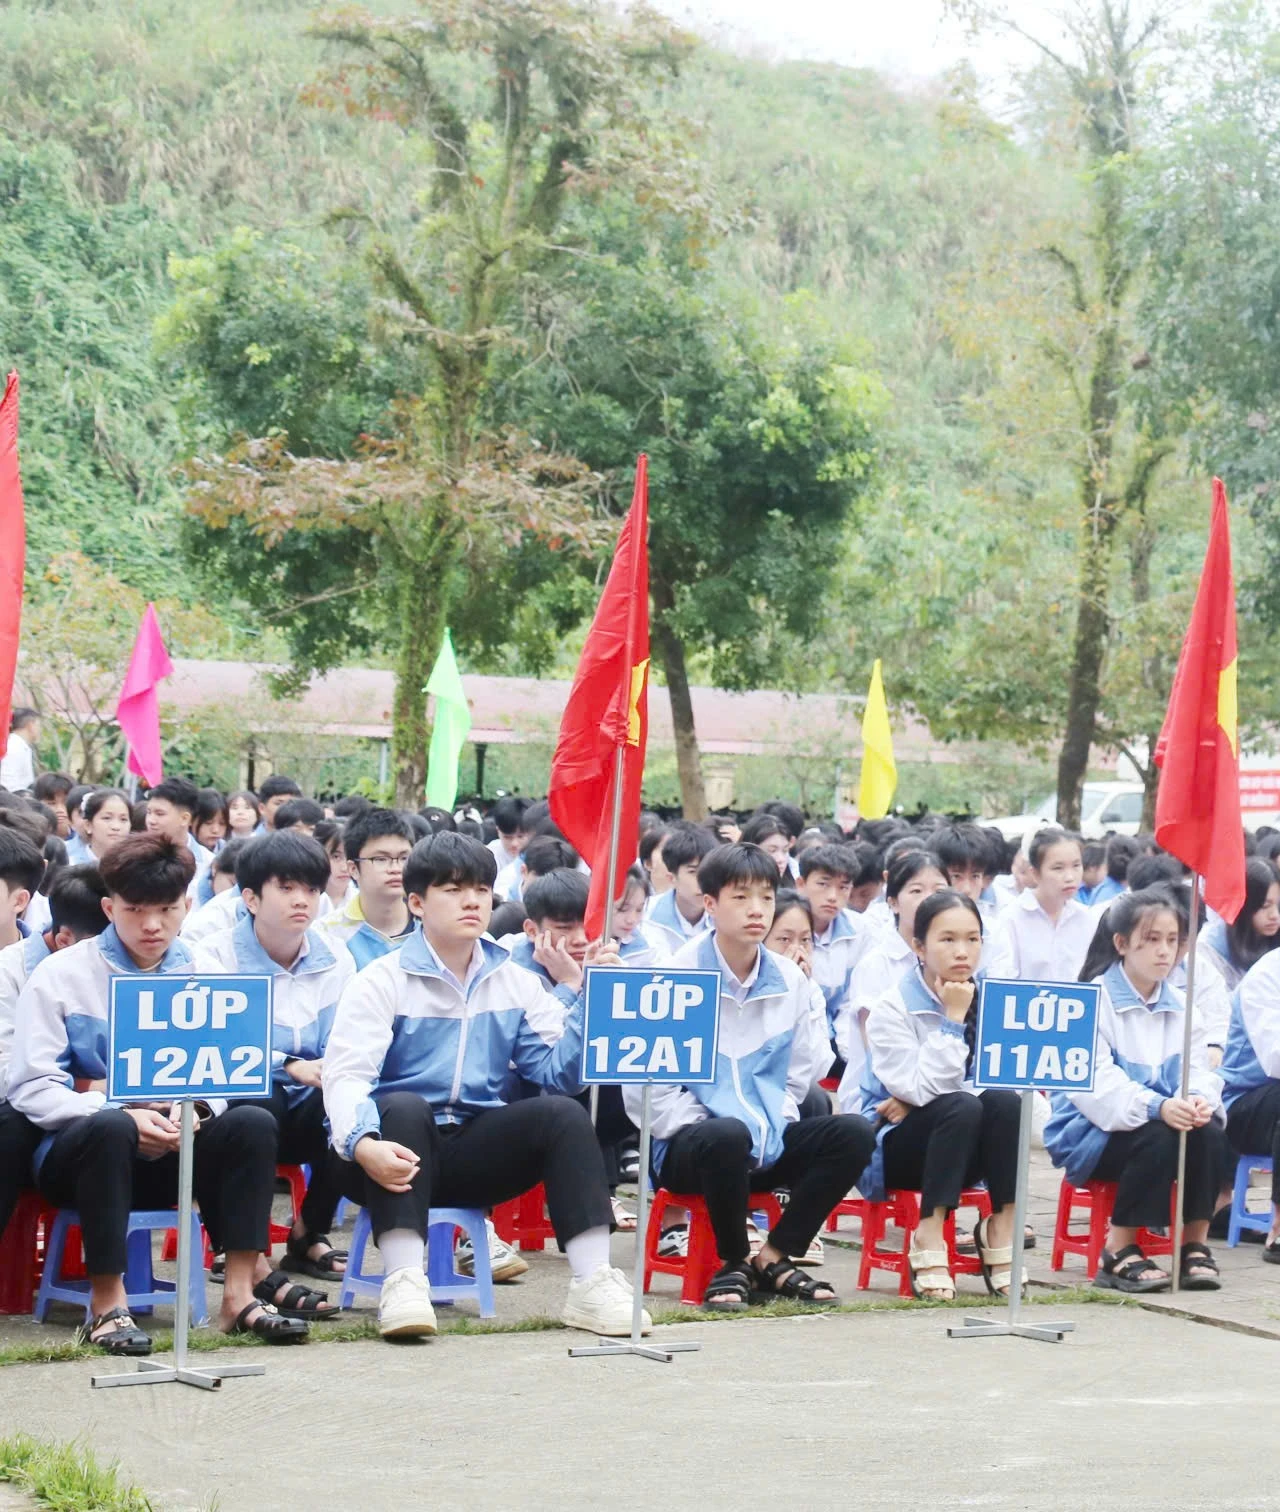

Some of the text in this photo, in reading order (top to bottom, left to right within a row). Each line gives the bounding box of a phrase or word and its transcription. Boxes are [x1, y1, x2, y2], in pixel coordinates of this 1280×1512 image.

[138, 982, 248, 1030] LỚP
[611, 976, 704, 1021] LỚP
[1003, 990, 1085, 1033] LỚP
[118, 1046, 264, 1087] 12A2
[588, 1036, 704, 1073] 12A1
[983, 1043, 1090, 1082] 11A8
